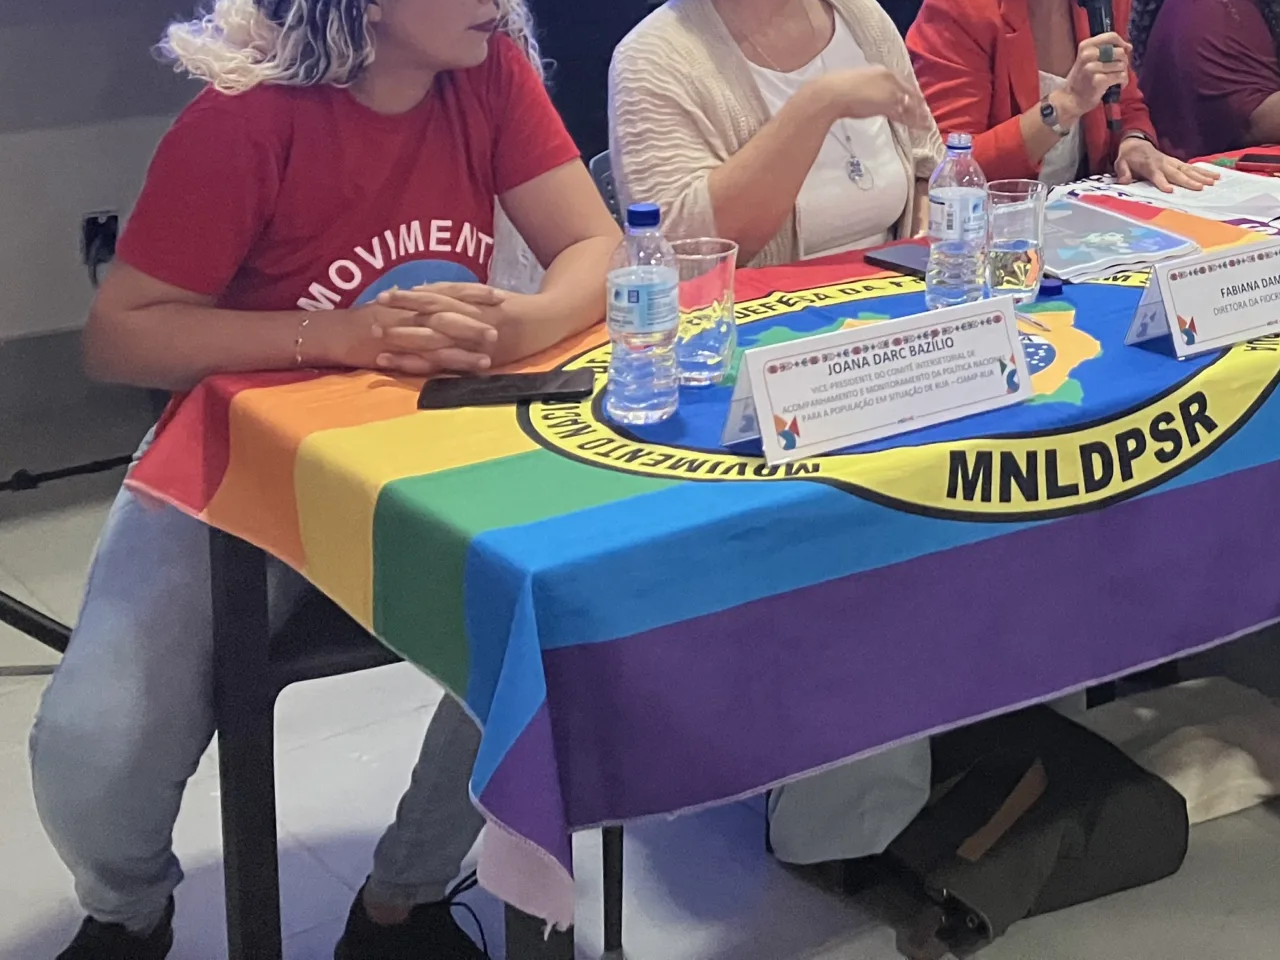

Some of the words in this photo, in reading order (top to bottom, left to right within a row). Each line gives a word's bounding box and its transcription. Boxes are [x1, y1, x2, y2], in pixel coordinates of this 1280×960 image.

[297, 219, 494, 312] MOVIMENT
[1213, 300, 1249, 316] DIRETORA
[1248, 298, 1259, 308] DA
[1220, 280, 1260, 299] FABIANA
[811, 372, 872, 394] VICE-PRESIDENTE
[874, 370, 885, 380] DO
[886, 361, 914, 377] COMITÊ
[966, 349, 976, 358] DE
[828, 356, 870, 376] JOANA
[873, 347, 907, 366] DARC
[909, 336, 954, 357] BAZÍLIO
[782, 389, 859, 414] ACOMPANHAMENTO
[866, 373, 930, 394] MONITORAMENTO
[931, 370, 941, 380] DA
[942, 361, 972, 377] POLÍTICA
[801, 409, 822, 422] PARA
[823, 408, 829, 417] A
[830, 397, 875, 416] POPULAÇÃO
[875, 395, 887, 405] EM
[889, 385, 923, 401] SITUAÇÃO
[924, 384, 934, 393] DE
[935, 380, 950, 390] RUA
[945, 390, 1219, 504] MNLDPSR
